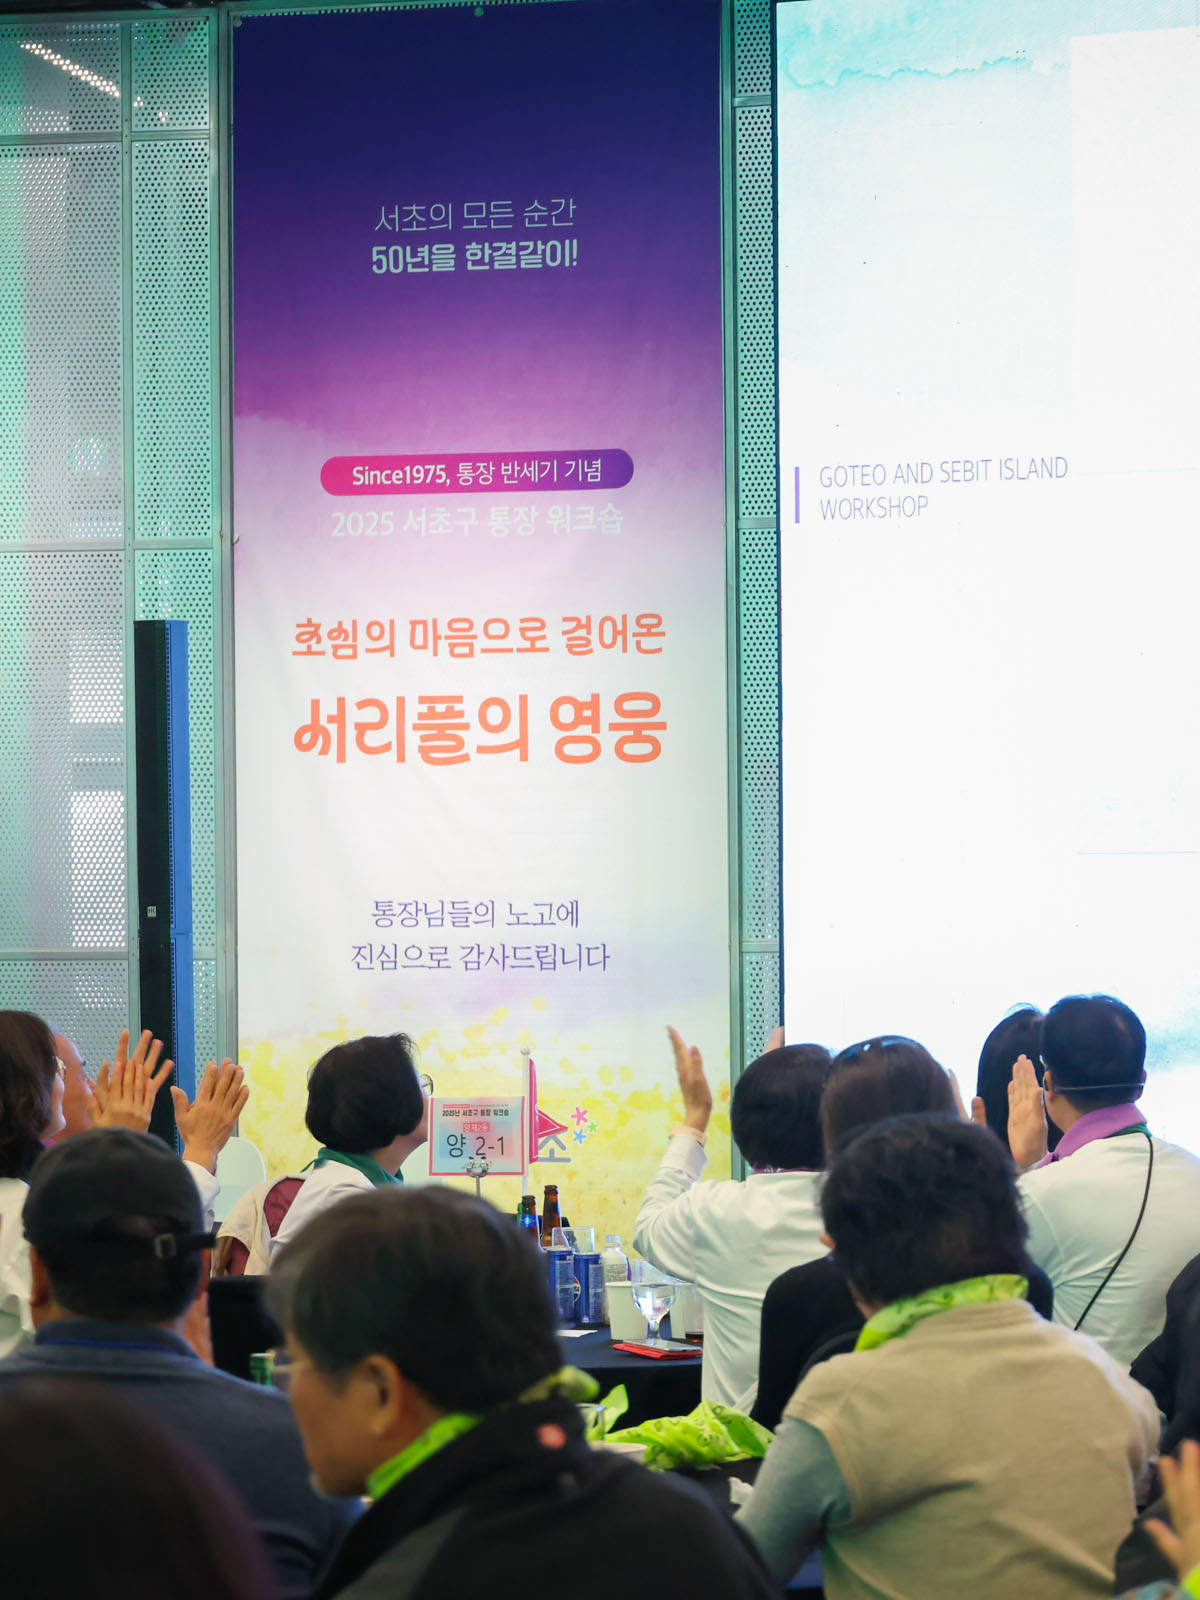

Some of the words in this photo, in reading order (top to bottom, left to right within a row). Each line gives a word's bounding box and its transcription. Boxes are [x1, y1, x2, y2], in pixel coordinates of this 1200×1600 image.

[374, 202, 452, 232] 서초의
[462, 200, 514, 229] 모든
[523, 198, 576, 228] 순간
[371, 243, 456, 274] 50년을
[465, 238, 578, 271] 한결같이!
[352, 464, 451, 487] Since1975,
[456, 461, 495, 485] 통장
[501, 459, 558, 484] 반세기
[564, 457, 602, 483] 기념
[819, 463, 886, 488] GOTEO
[893, 462, 933, 485] AND
[940, 459, 992, 483] SEBIT
[999, 456, 1068, 481] ISLAND
[331, 511, 394, 537] 2025
[403, 507, 479, 537] 서초구
[487, 505, 538, 537] 통장
[547, 502, 624, 535] 워크숍
[819, 495, 929, 521] WORKSHOP
[292, 617, 395, 660] 초심의
[409, 616, 550, 658] 마음으로
[561, 612, 666, 657] 걸어온
[293, 693, 529, 766] 서리풀의
[549, 691, 667, 764] 영웅
[371, 900, 495, 928] 통장님들의
[505, 899, 579, 928] 노고에
[351, 942, 452, 971] 진심으로
[459, 942, 611, 972] 감사드립니다
[446, 1133, 466, 1158] 양
[475, 1136, 504, 1156] 2-1
